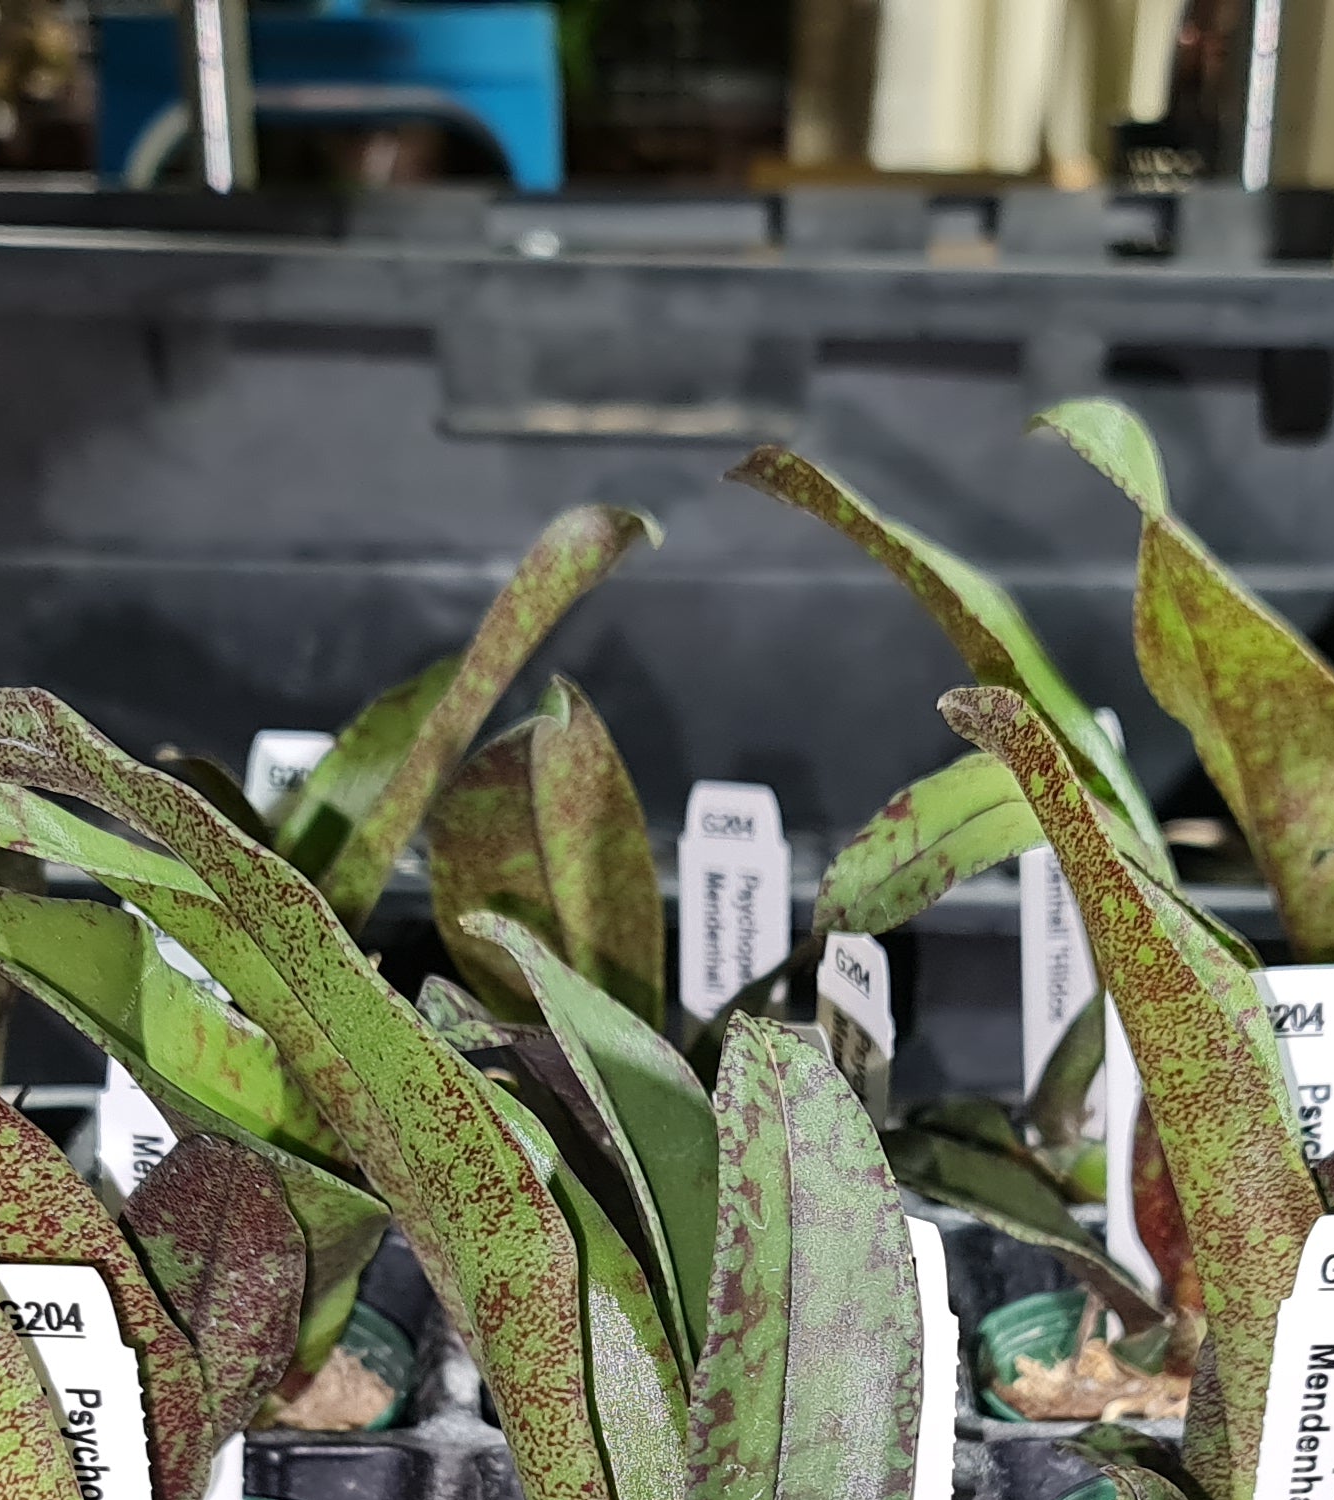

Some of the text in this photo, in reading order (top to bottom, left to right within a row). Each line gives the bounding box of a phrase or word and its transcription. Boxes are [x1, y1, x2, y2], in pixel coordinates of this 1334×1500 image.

[702, 813, 755, 835] G204
[835, 947, 871, 994] G204
[1266, 1003, 1324, 1032] 204
[1298, 1085, 1331, 1164] Psyc
[0, 1300, 84, 1332] G204
